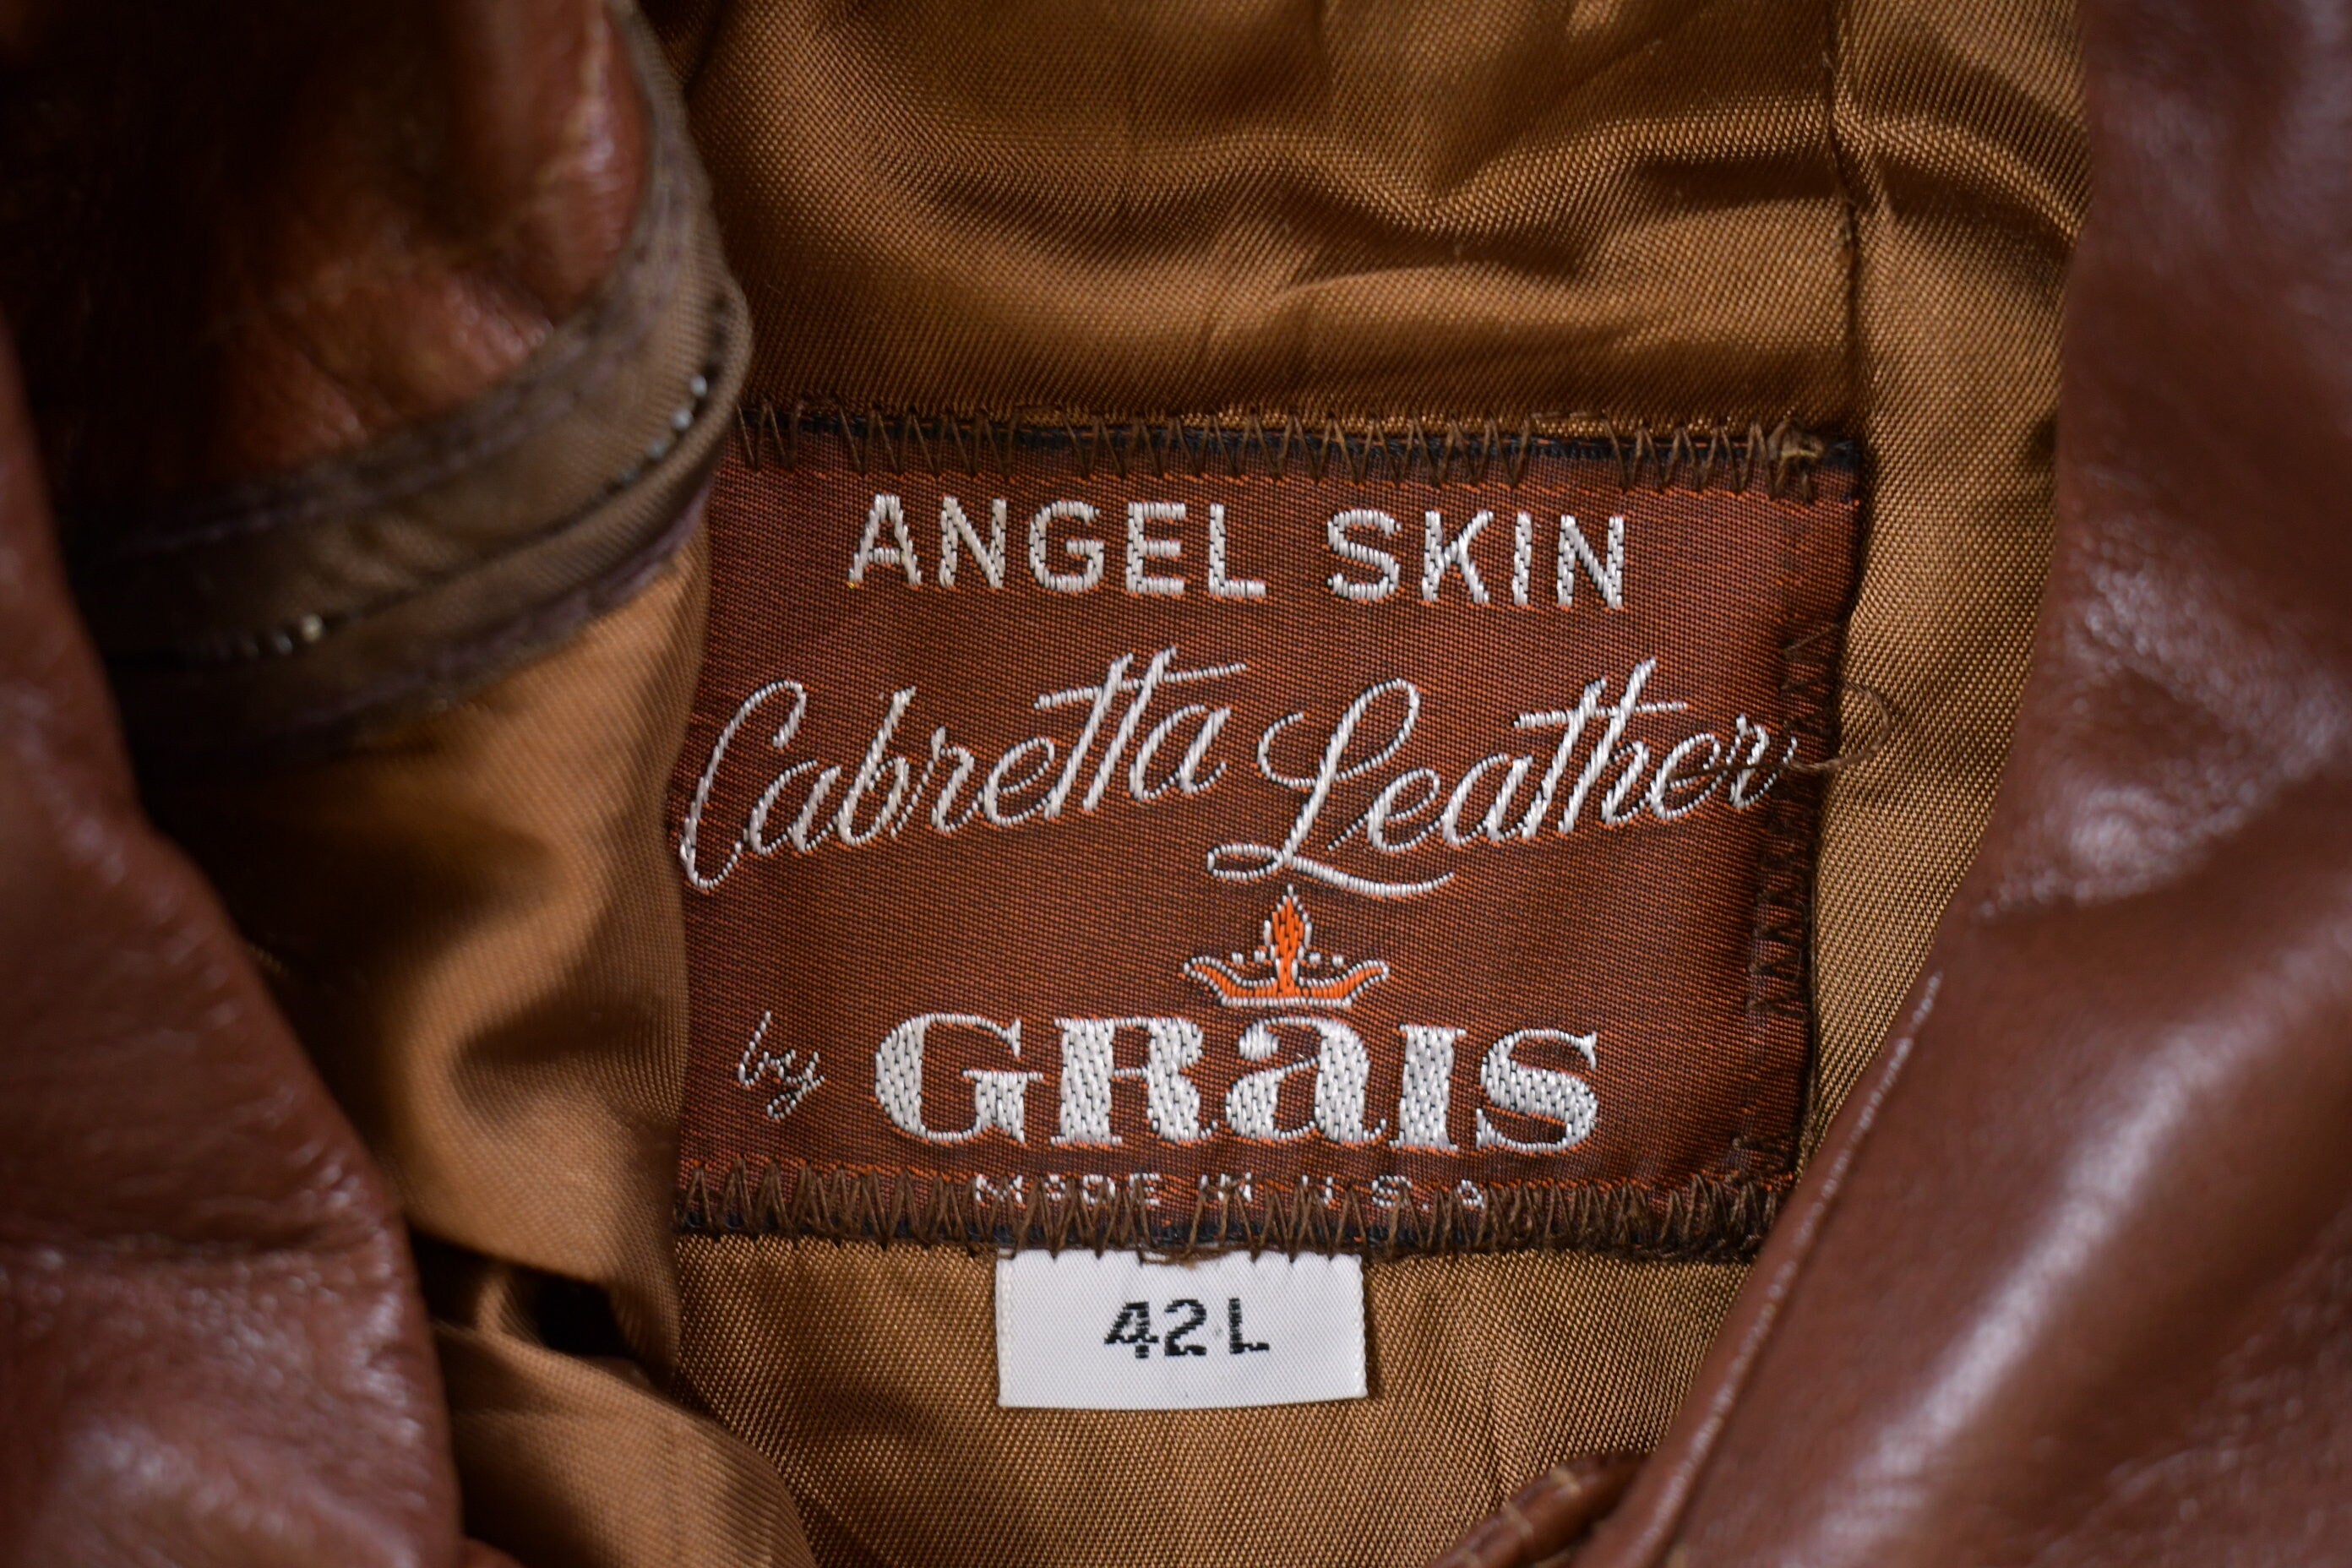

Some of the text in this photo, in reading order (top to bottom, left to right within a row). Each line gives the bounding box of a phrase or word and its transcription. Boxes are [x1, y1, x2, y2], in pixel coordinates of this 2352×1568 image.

[847, 492, 1626, 609] ANGEL SKIN
[679, 645, 1798, 900] Cabretta Leather
[737, 1010, 825, 1120] by
[1103, 1297, 1270, 1359] 42L
